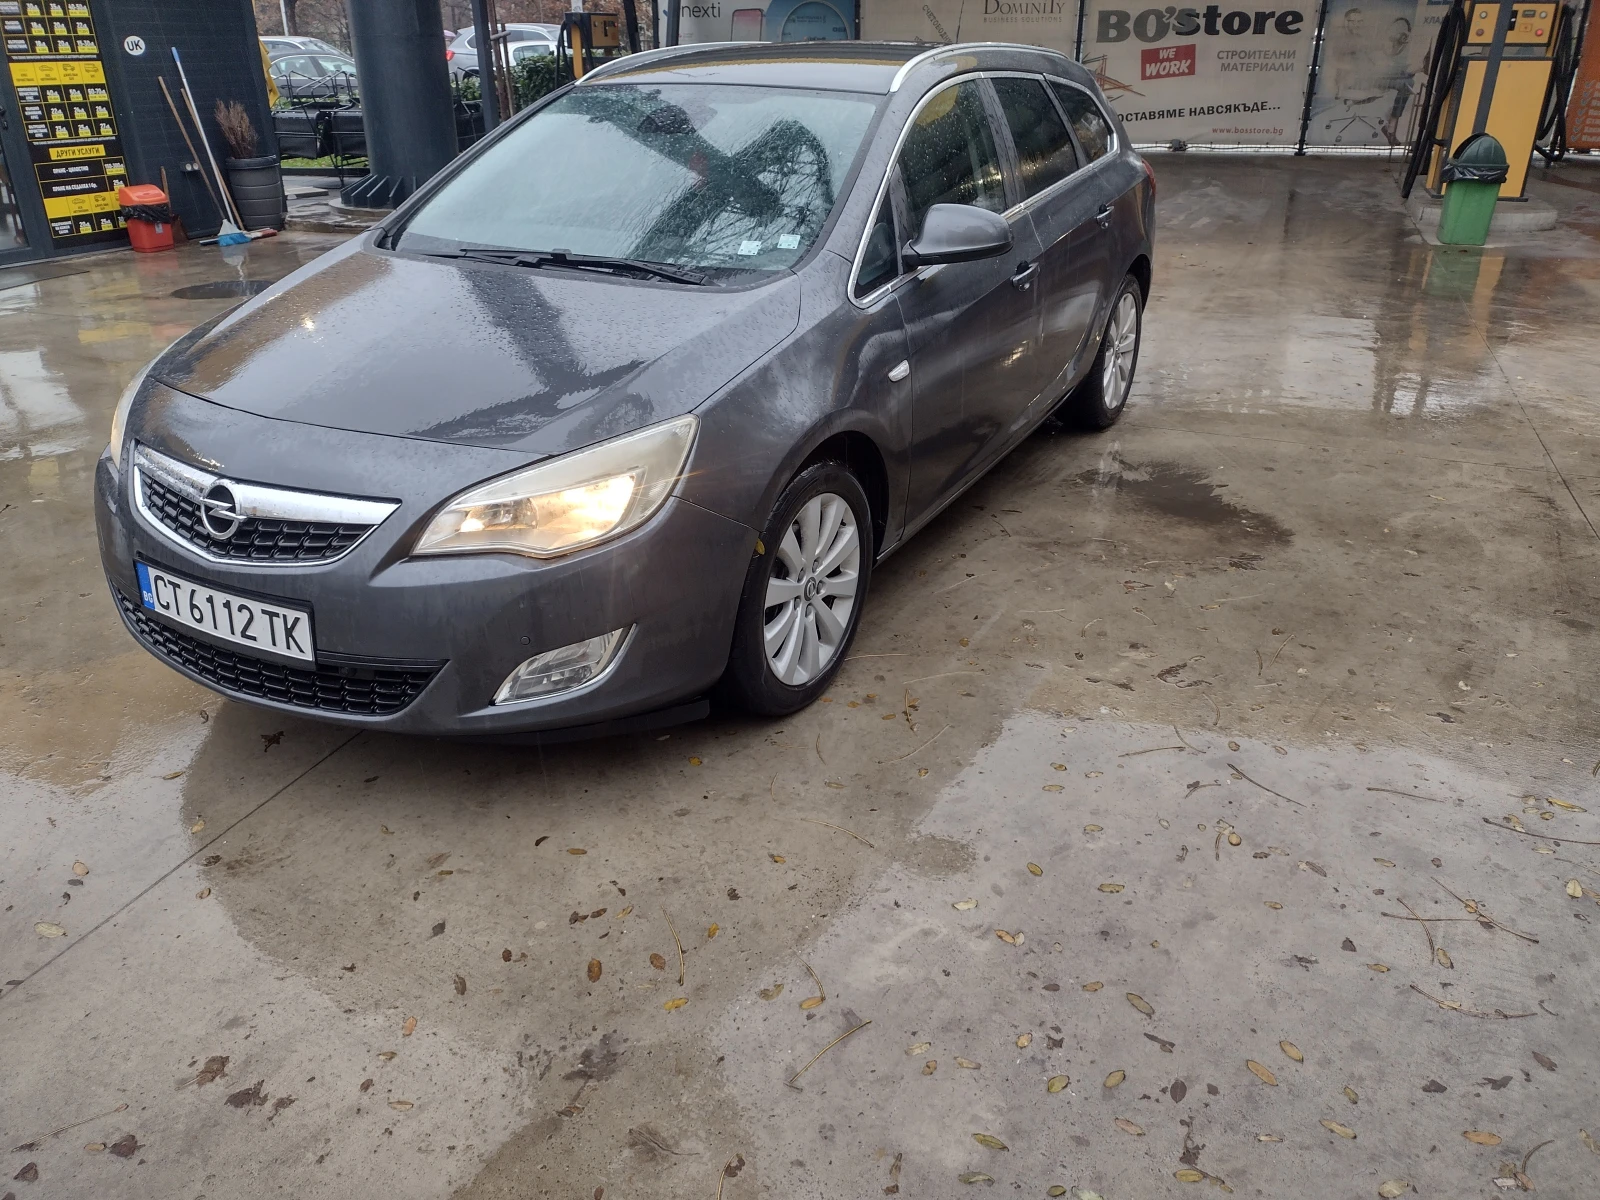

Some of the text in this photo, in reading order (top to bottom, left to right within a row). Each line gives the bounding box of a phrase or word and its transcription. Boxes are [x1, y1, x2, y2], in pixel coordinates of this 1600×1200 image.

[681, 2, 721, 18] nexti
[983, 16, 1019, 24] BUSINESS
[126, 40, 143, 52] UK
[1159, 47, 1177, 59] WE
[1216, 49, 1297, 61] СТРОИТЕЛНИ
[1144, 59, 1192, 77] WORK
[1220, 62, 1295, 72] МАТЕРИАЛИ
[1118, 108, 1186, 122] ОСТАВЯМЕ
[1211, 126, 1284, 136] www.bosstore.bg
[56, 147, 101, 158] ДРУГИ УСЛУГИ
[143, 590, 154, 603] BG
